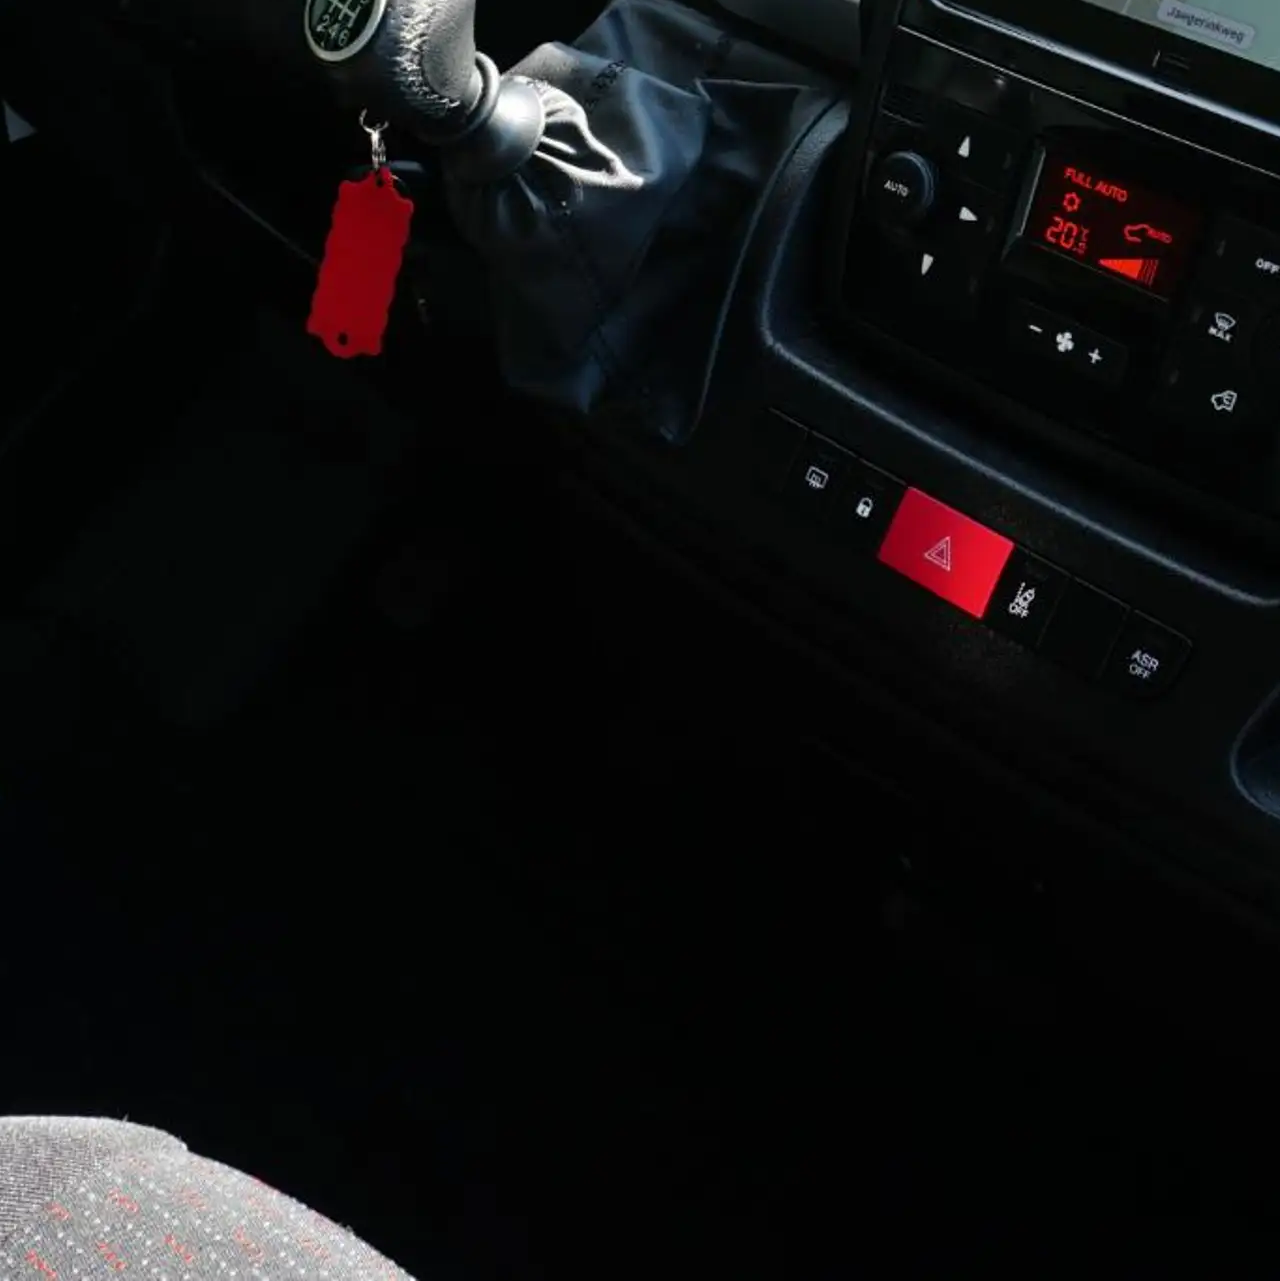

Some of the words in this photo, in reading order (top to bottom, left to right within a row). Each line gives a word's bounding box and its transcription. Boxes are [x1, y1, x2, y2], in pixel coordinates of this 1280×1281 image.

[883, 179, 909, 197] AUTO
[1063, 167, 1093, 189] FULL
[1094, 181, 1128, 202] AUTO
[1255, 258, 1280, 274] OFF
[1208, 325, 1233, 343] MAX
[1131, 650, 1159, 671] ASR
[1129, 663, 1152, 679] OFF
